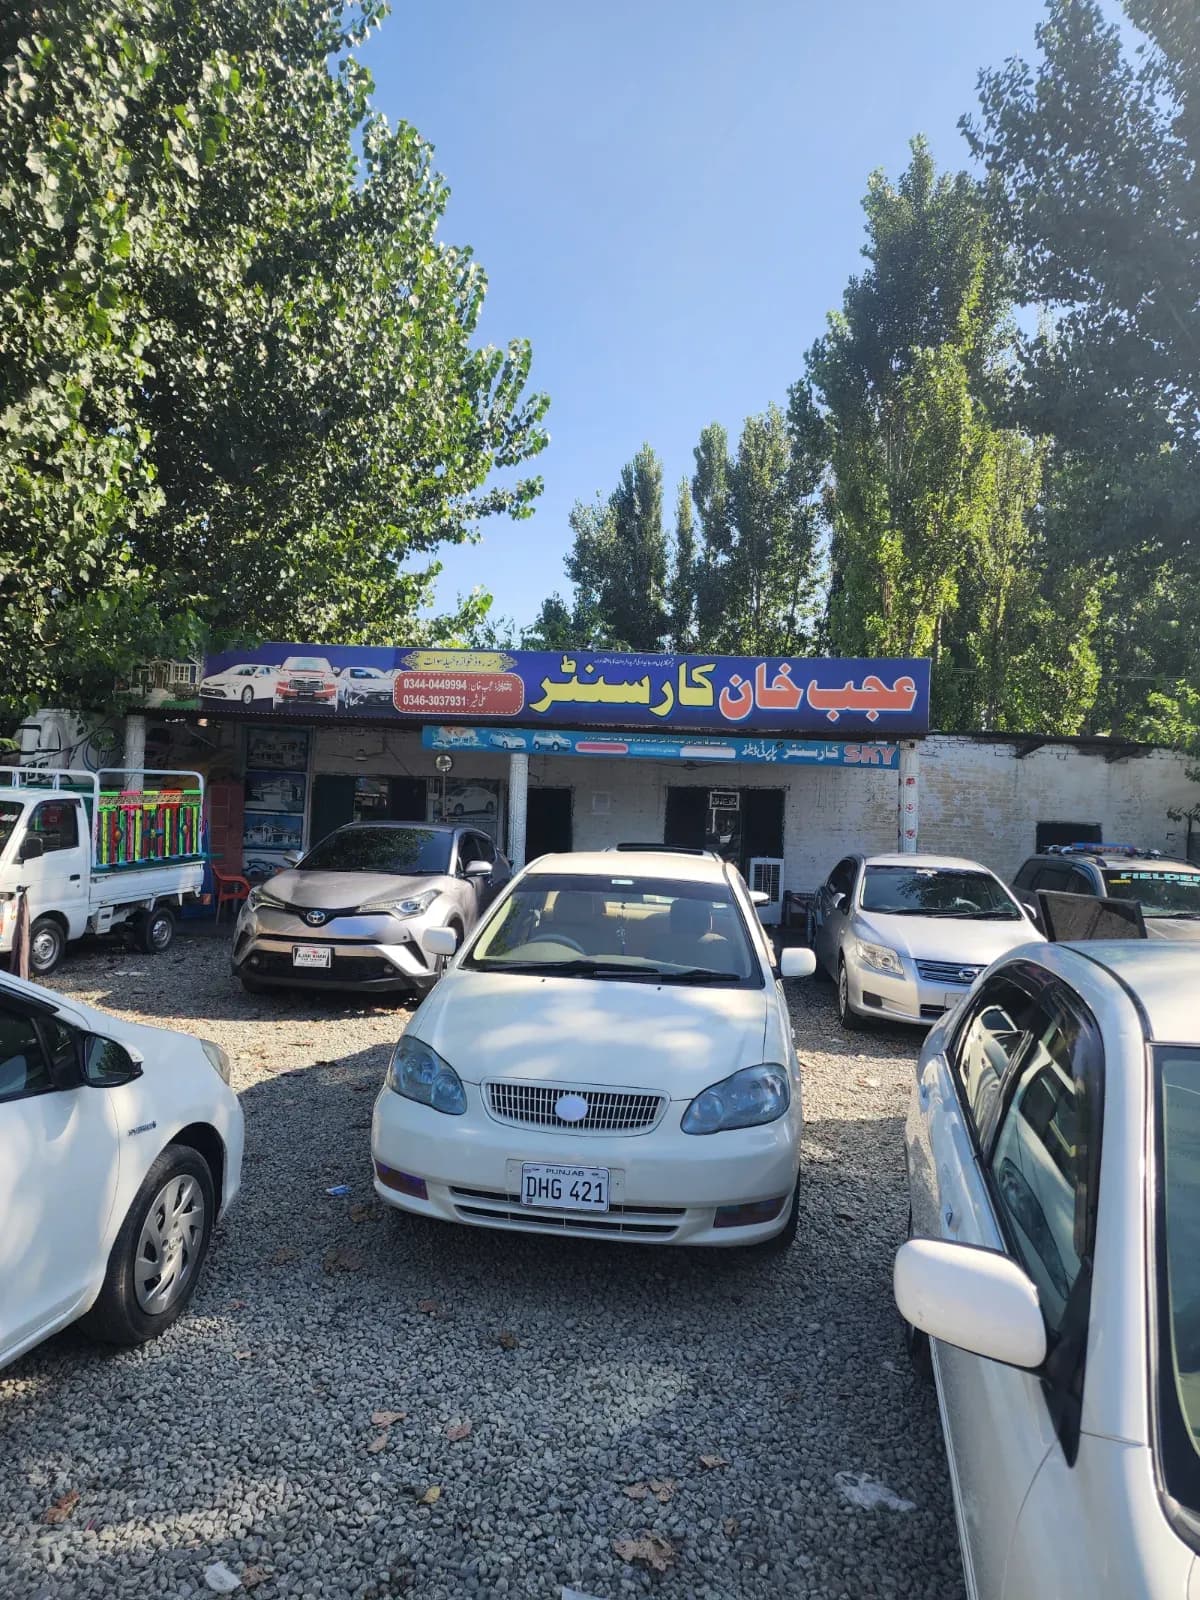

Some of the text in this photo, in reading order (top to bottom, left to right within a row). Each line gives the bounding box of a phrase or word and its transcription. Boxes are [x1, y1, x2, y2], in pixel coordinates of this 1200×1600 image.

[403, 678, 467, 690] 0344-0449994
[529, 654, 917, 722] عجب خان کار سنٹر
[403, 694, 466, 706] 0346-3037931
[843, 744, 897, 765] SKY
[545, 1168, 585, 1177] PUNJAB
[526, 1176, 605, 1204] DHG 421
